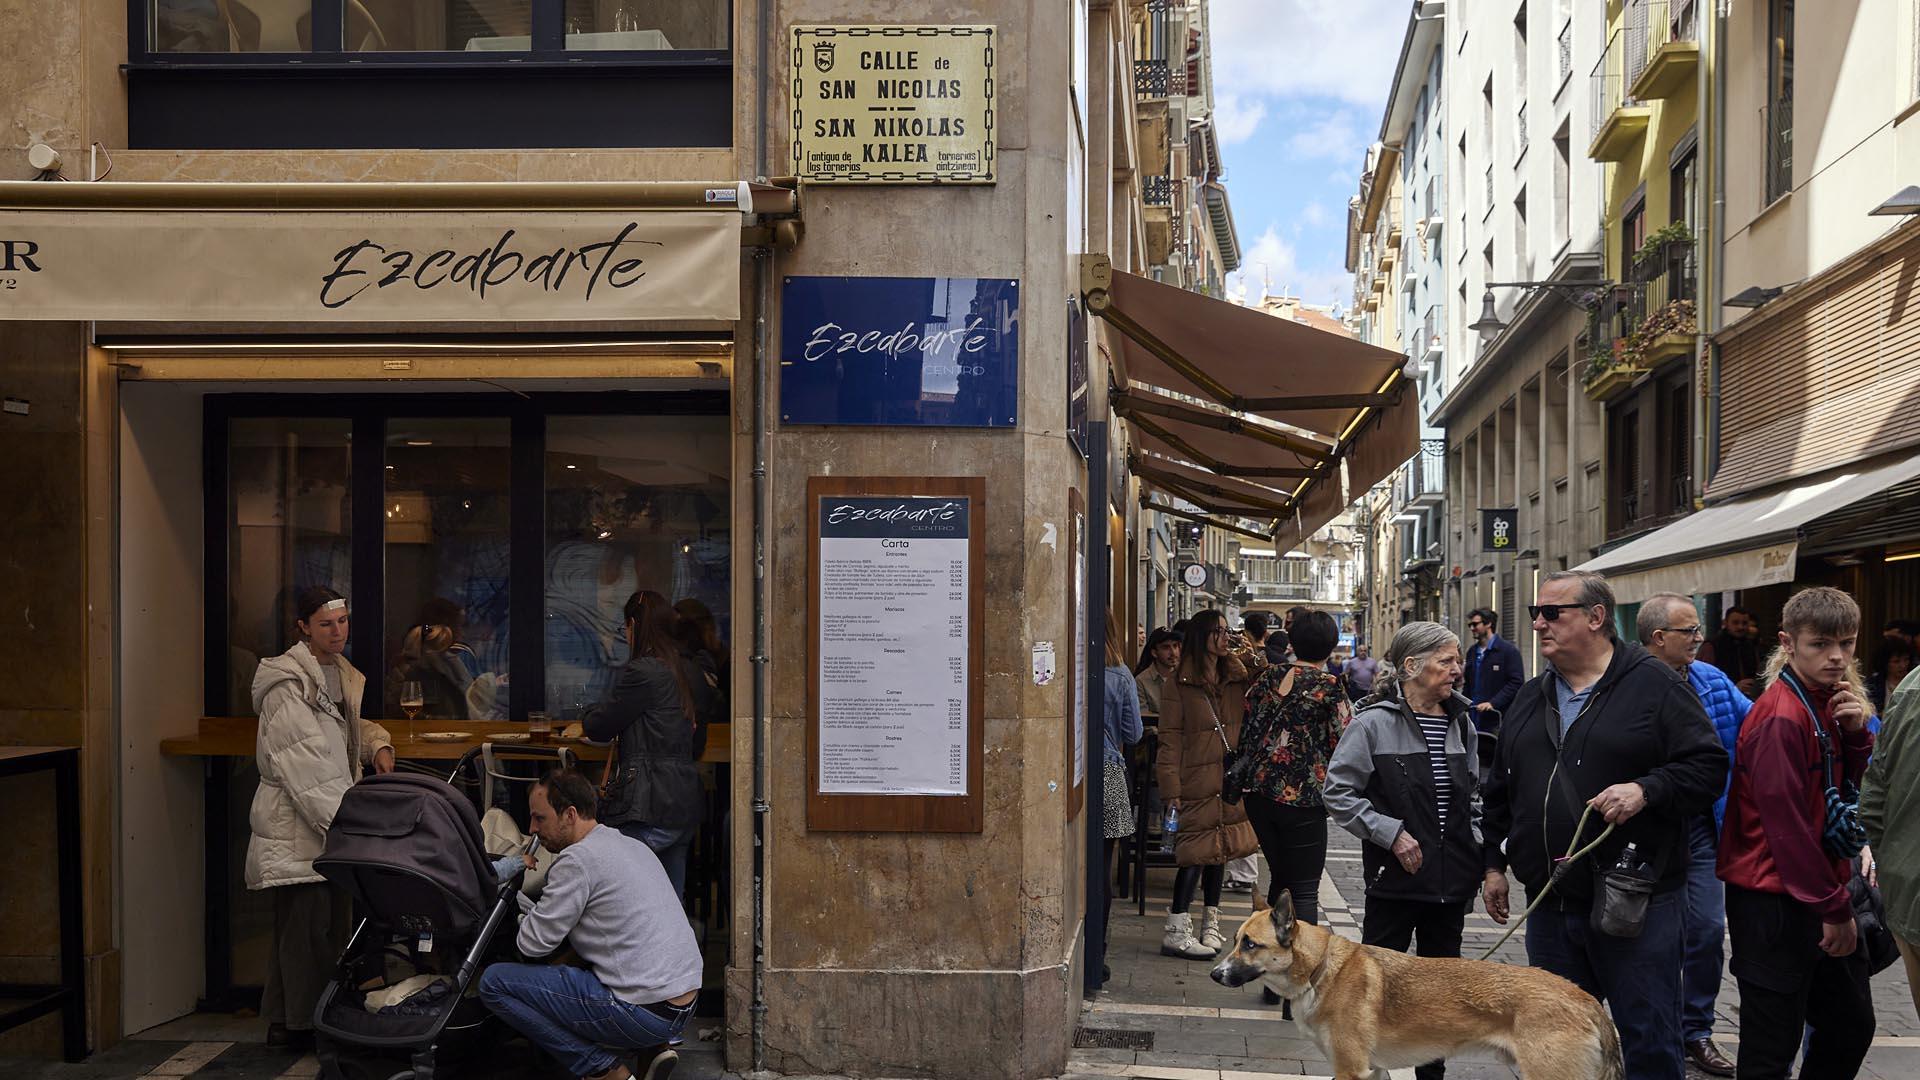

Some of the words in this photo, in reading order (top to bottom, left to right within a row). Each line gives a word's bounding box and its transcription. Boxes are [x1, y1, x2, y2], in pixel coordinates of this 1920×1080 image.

[861, 51, 918, 70] CALLE
[935, 57, 949, 70] de
[820, 80, 856, 99] SAN
[877, 79, 961, 99] NICOLAS
[814, 118, 856, 137] SAN
[874, 118, 965, 137] NIKOLAS
[811, 151, 840, 163] antigua
[842, 151, 852, 161] de
[863, 143, 928, 163] KALEA
[320, 222, 664, 308] Ezcabarte
[804, 317, 1000, 362] Ezcabarte
[923, 365, 985, 376] CENTRO
[828, 502, 962, 524] Ezcabarte
[881, 538, 909, 549] Carta
